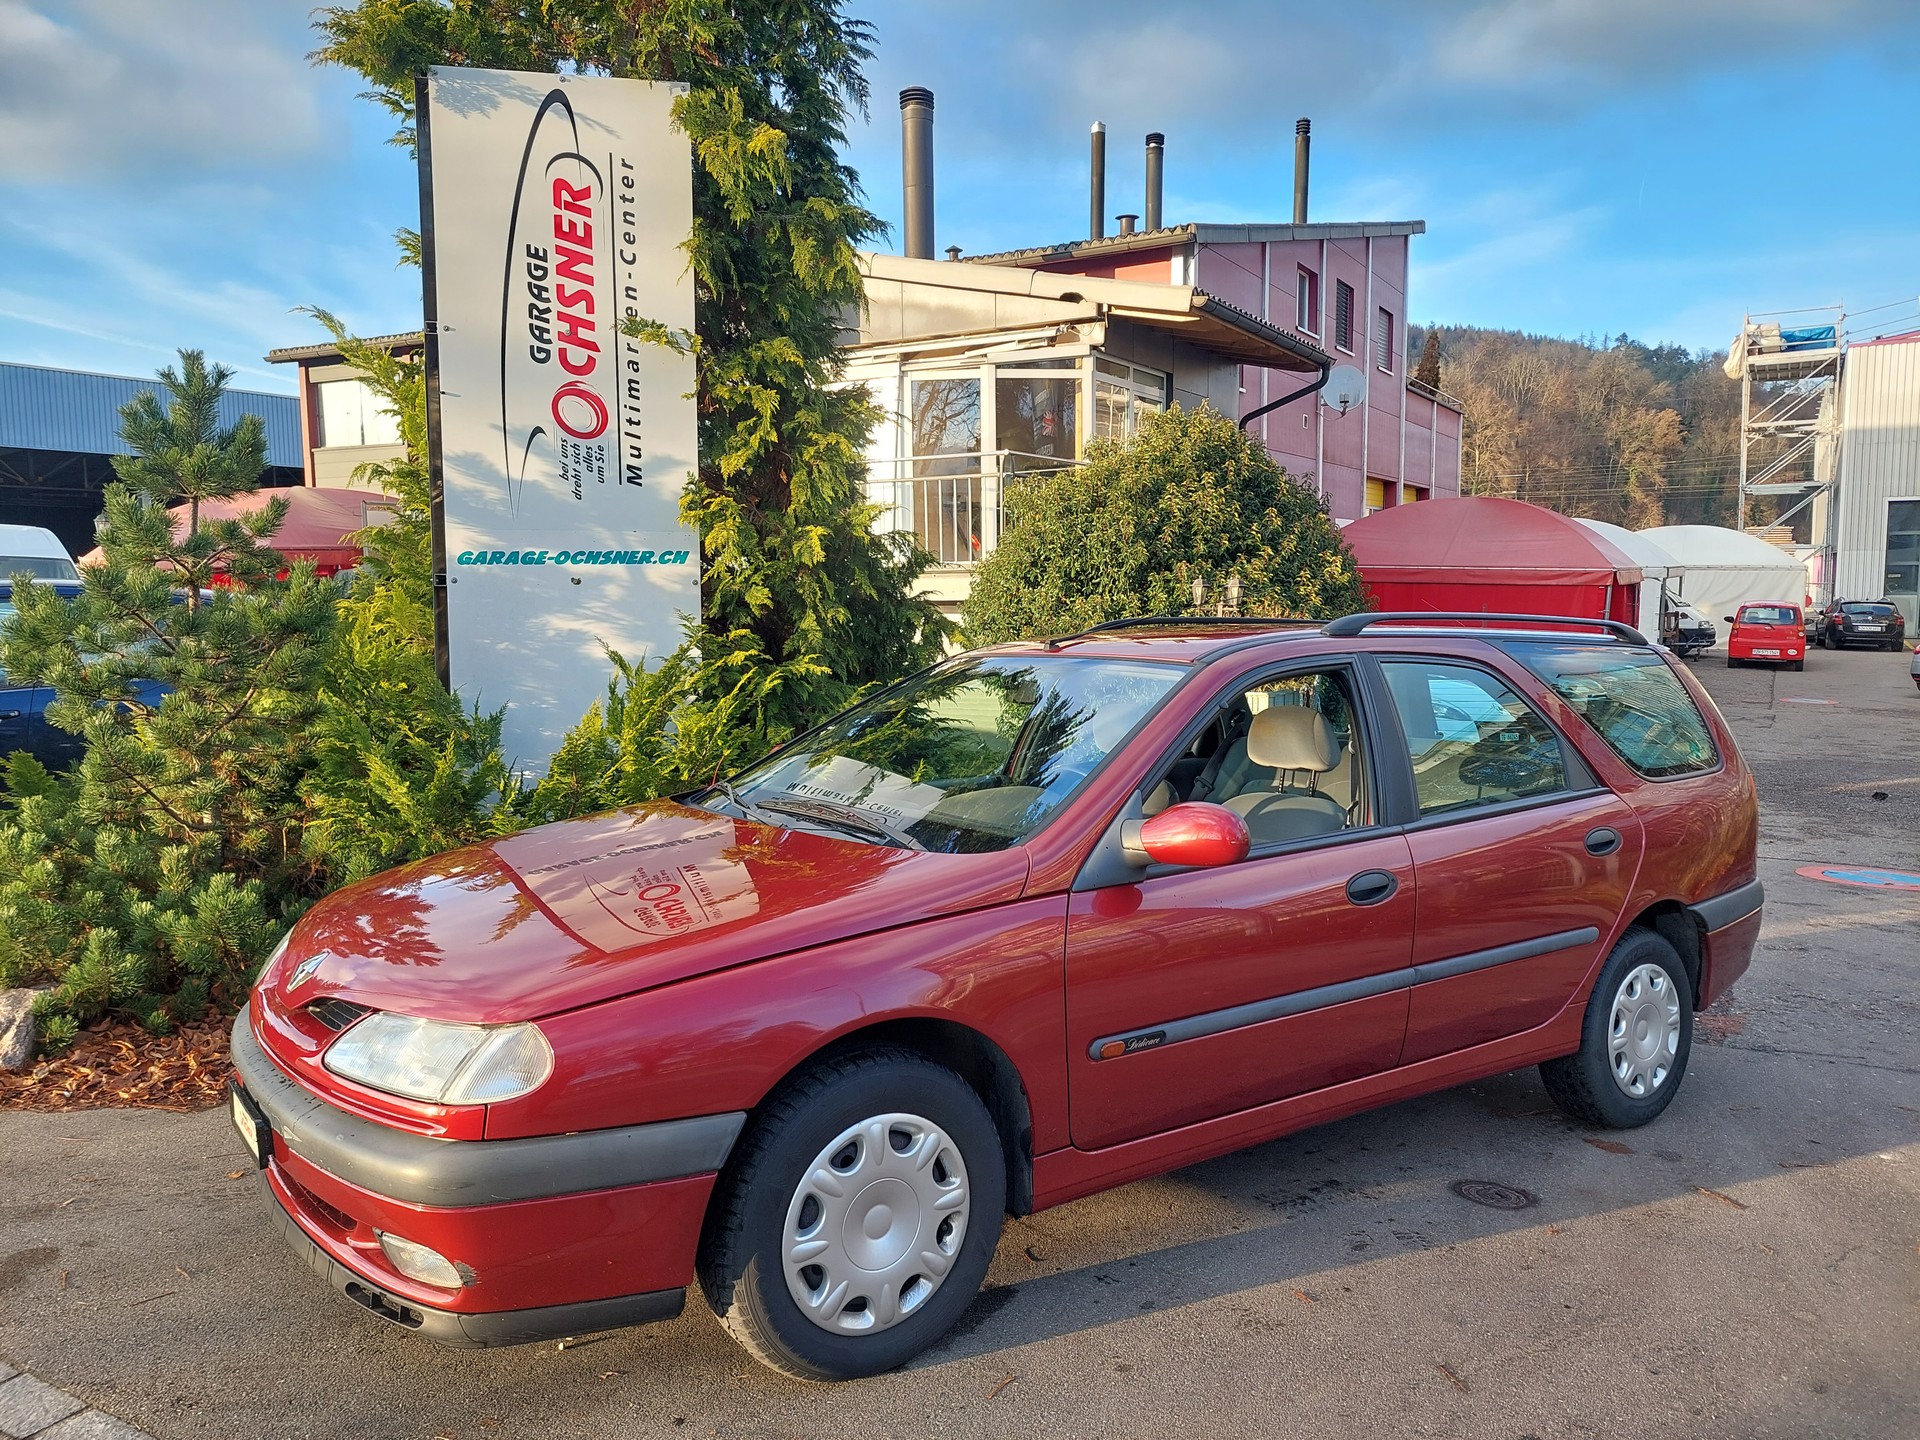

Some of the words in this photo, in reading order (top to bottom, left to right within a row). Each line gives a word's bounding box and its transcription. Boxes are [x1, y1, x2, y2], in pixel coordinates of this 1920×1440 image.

[526, 243, 553, 364] GARAGE
[551, 177, 609, 440] OCHSNER
[619, 158, 643, 487] Multimaren-Center
[561, 437, 569, 459] uns
[570, 443, 581, 466] sich
[582, 445, 594, 473] alles
[594, 444, 605, 464] Sie
[559, 460, 569, 481] bei
[597, 466, 605, 484] um
[571, 468, 582, 500] dreht
[456, 550, 690, 566] GARAGE-OCHSNER.CH
